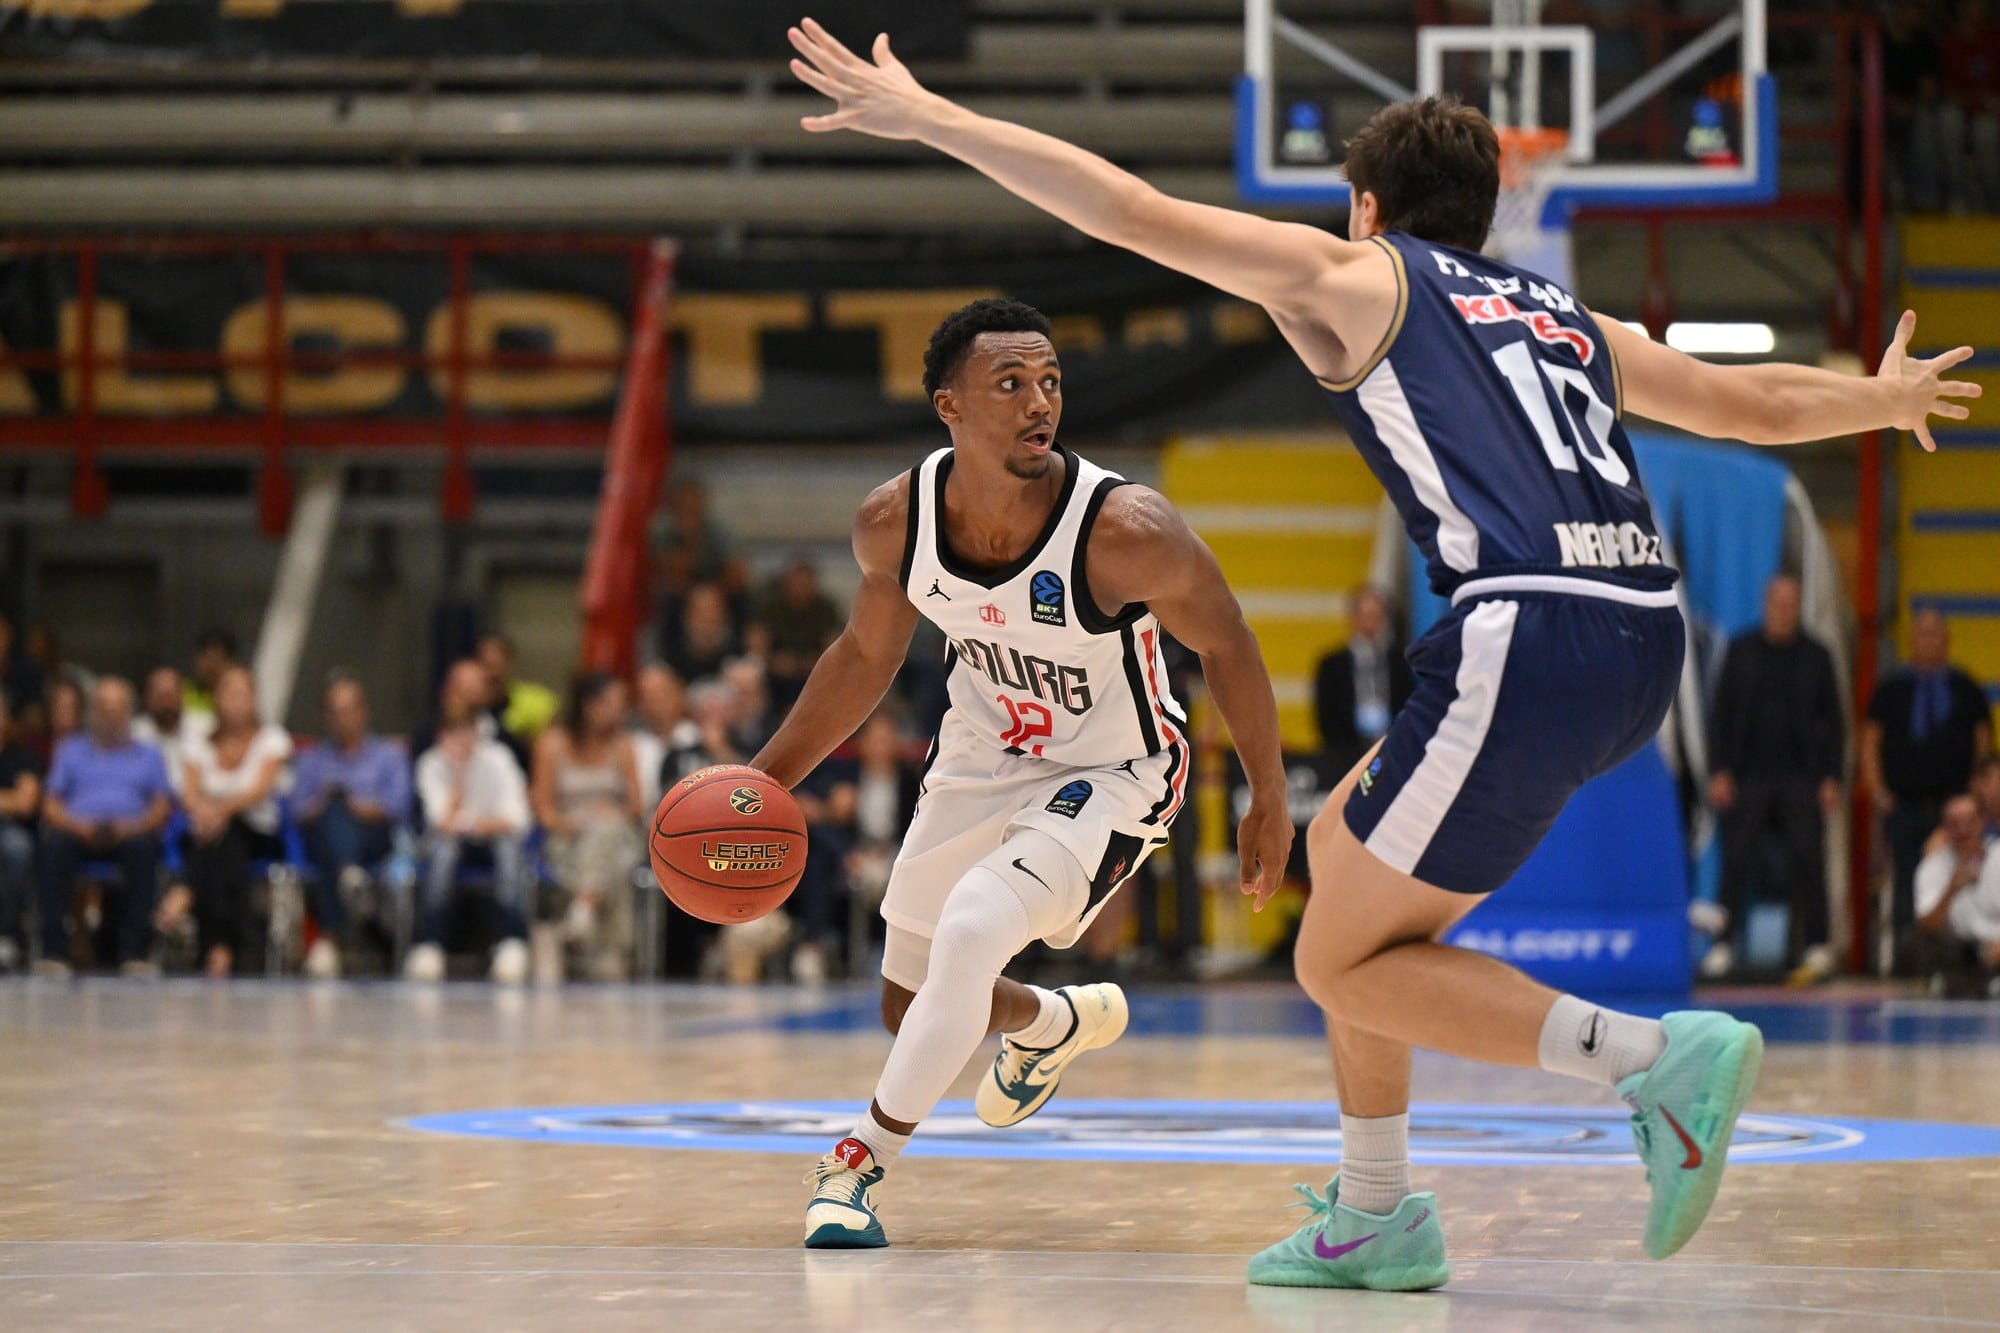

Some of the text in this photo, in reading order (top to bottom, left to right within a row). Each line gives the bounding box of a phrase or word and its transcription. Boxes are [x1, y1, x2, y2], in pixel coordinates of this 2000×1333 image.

[0, 289, 1002, 414] LCOTT
[1491, 340, 1630, 488] 10
[1036, 603, 1059, 613] BKT
[1033, 612, 1063, 623] EuroCup
[702, 841, 789, 860] LEGACY
[731, 861, 783, 871] 1000
